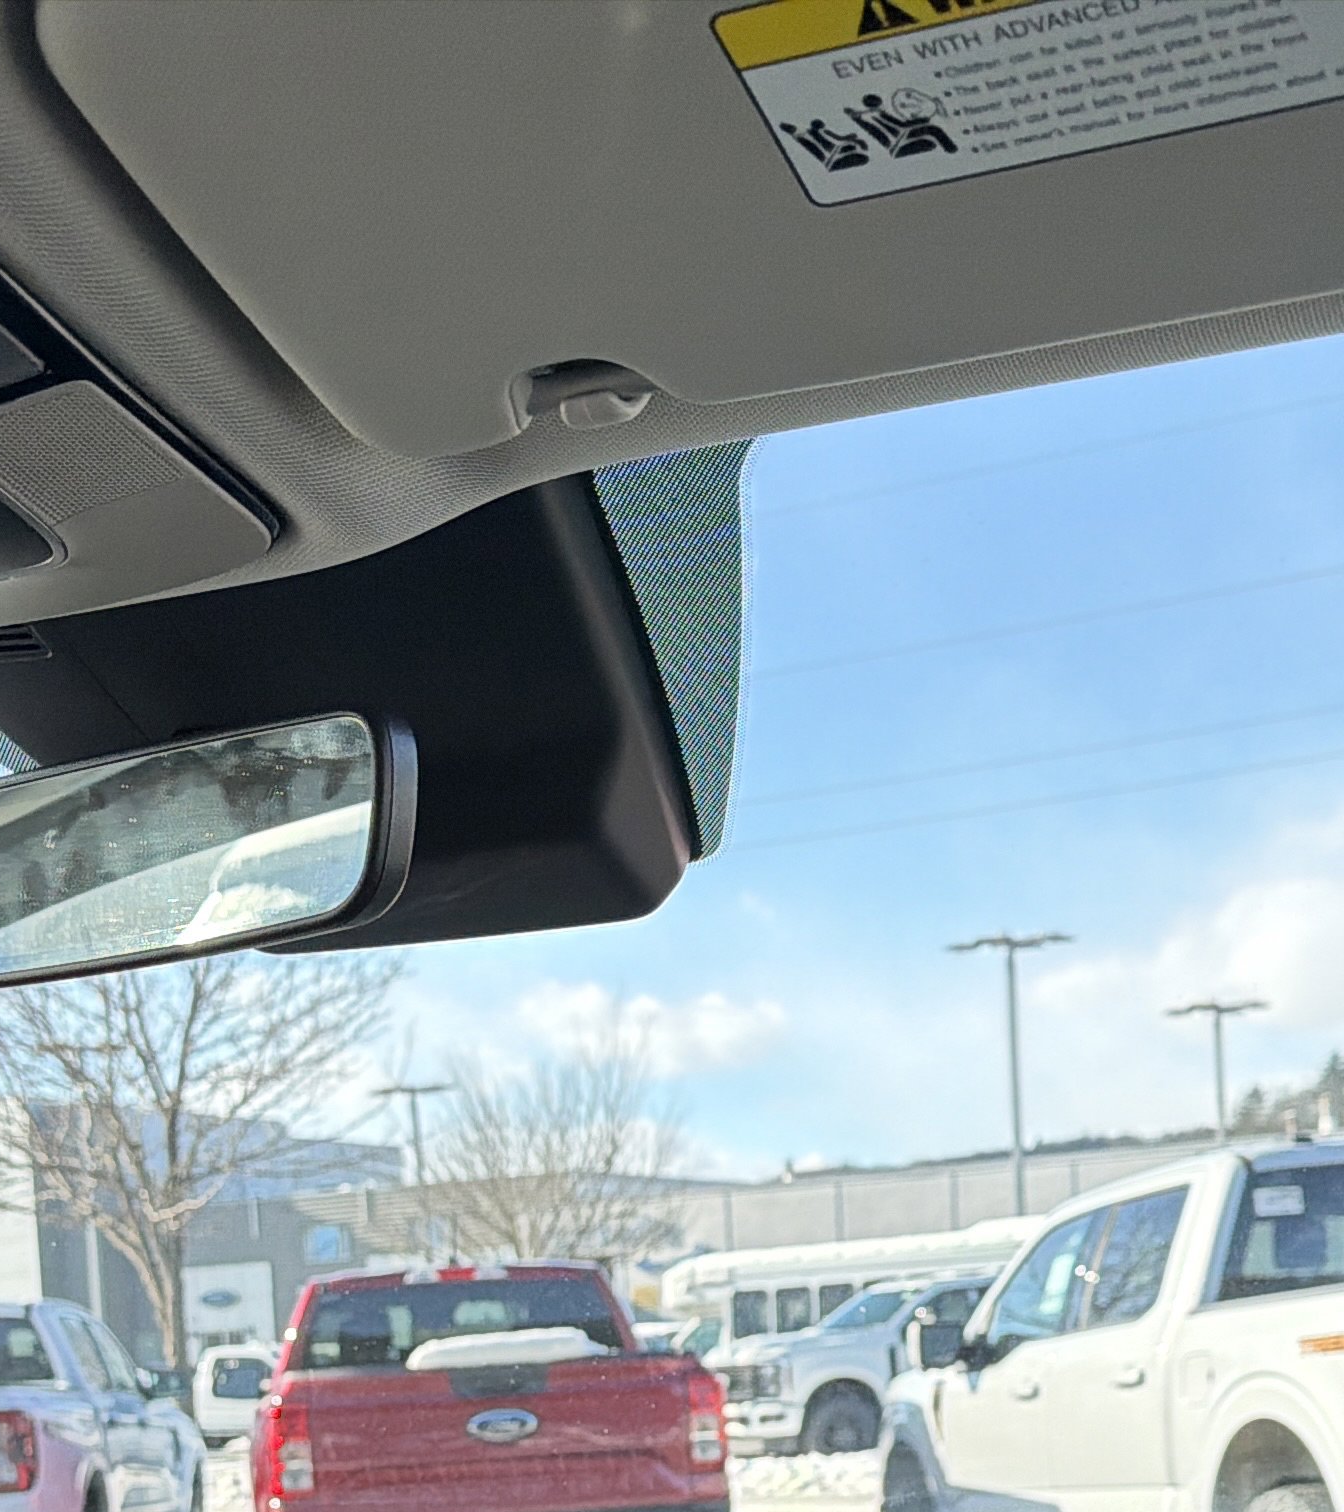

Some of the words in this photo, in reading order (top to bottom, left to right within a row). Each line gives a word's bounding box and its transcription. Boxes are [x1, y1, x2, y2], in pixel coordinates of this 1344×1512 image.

[832, 49, 905, 80] EVEN
[913, 31, 982, 60] WITH
[993, 0, 1141, 42] ADVANCED
